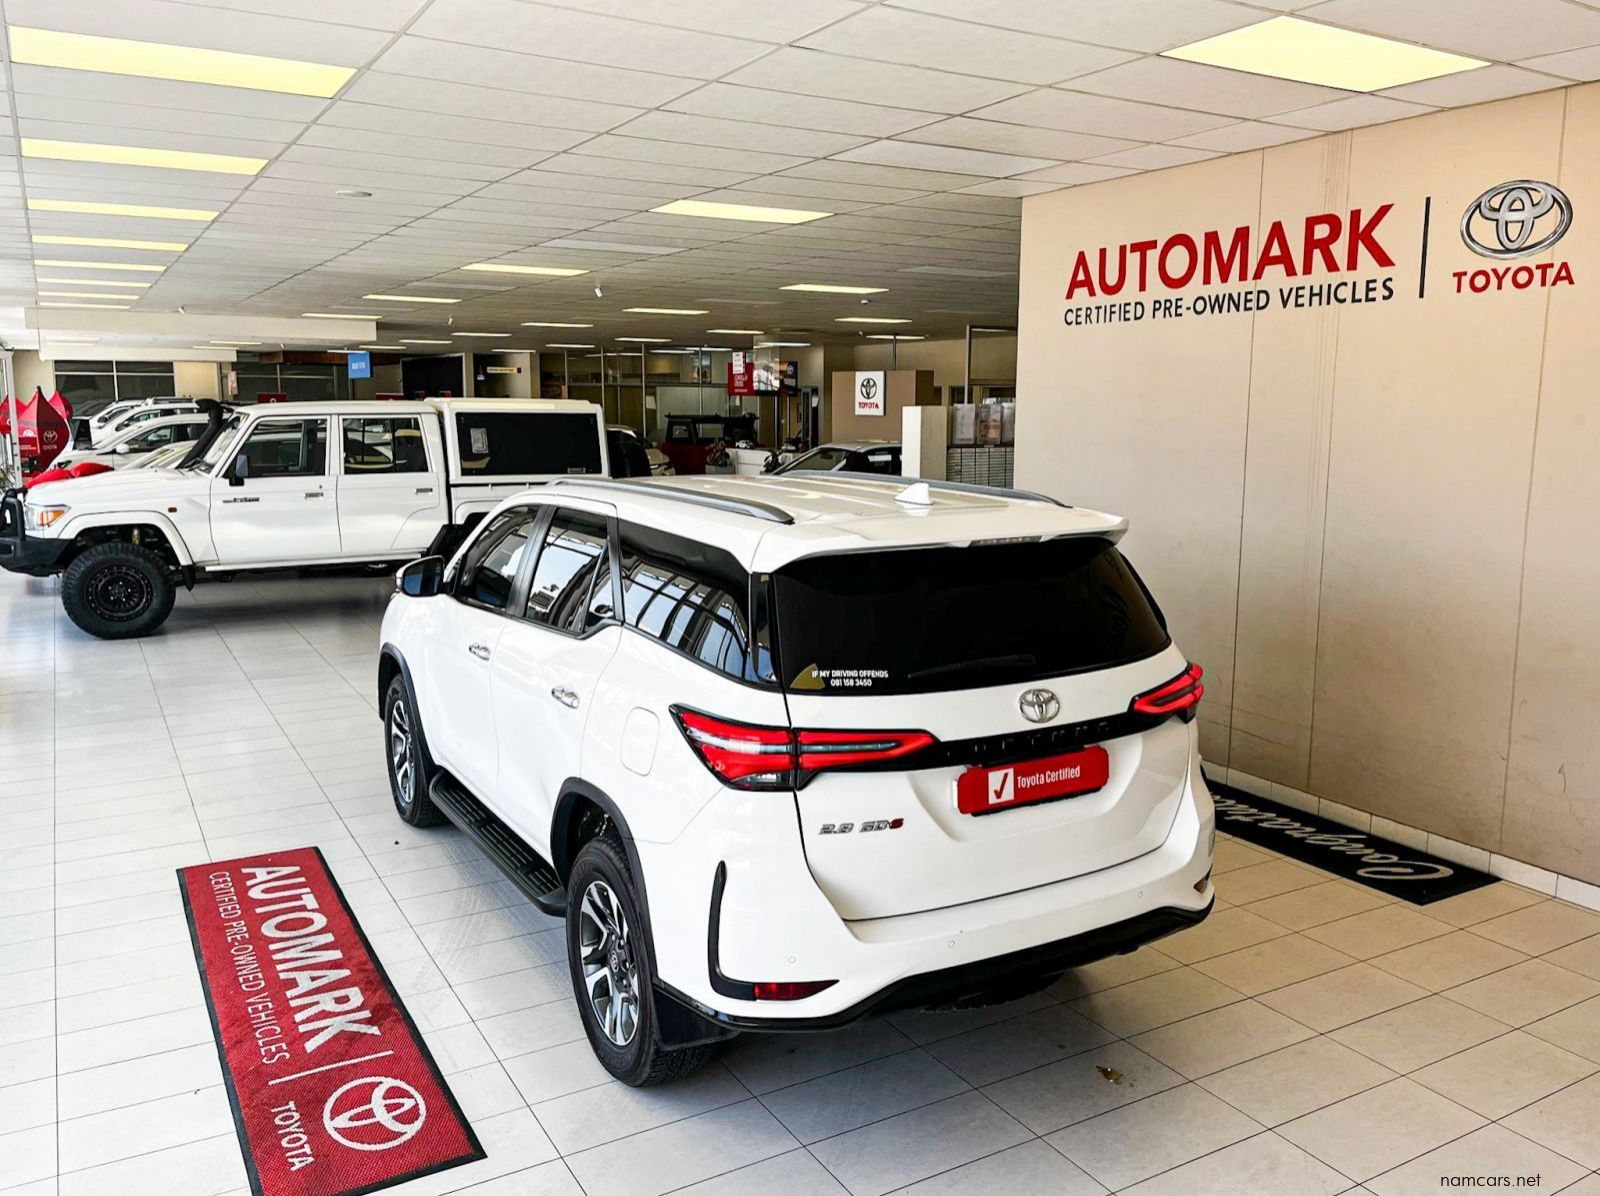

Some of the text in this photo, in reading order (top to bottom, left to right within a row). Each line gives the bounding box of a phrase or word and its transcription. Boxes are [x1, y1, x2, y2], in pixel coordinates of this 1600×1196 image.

[1065, 203, 1396, 301] AUTOMARK
[1063, 277, 1394, 326] CERTIFIED PRE-OWNED VEHICLES
[1452, 261, 1575, 294] TOYOTA
[858, 402, 880, 410] TOYOTA
[811, 670, 889, 679] IF MY DRIVING OFFENDS
[830, 679, 843, 687] 081
[1017, 765, 1081, 789] Toyota Certified
[1210, 792, 1454, 880] Congratu
[208, 871, 291, 1065] CERTIFIED PRE-OWNED VEHICLES
[240, 865, 382, 1054] AUTOMARK
[270, 1100, 315, 1172] TOYOTA
